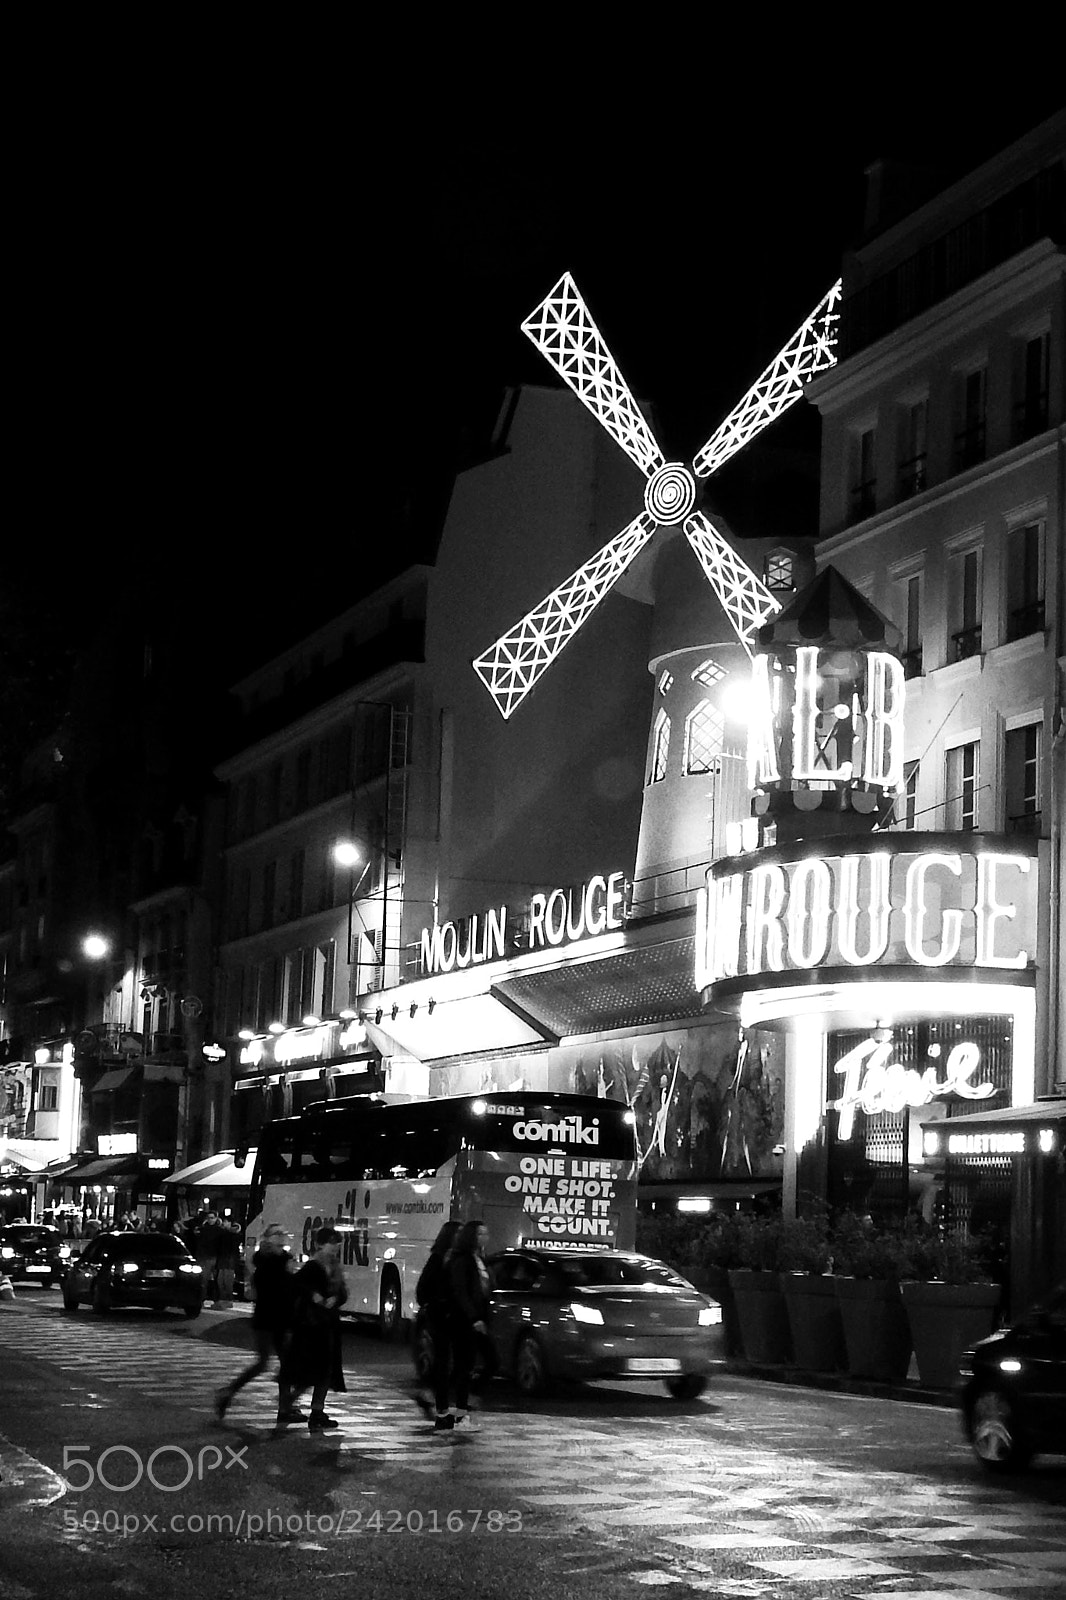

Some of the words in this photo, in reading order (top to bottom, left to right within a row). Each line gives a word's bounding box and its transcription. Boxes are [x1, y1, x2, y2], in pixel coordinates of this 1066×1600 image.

[421, 904, 507, 973] MOULIN
[529, 871, 624, 949] ROUGE
[746, 852, 1030, 972] ROUGE
[512, 1116, 599, 1145] contiki
[520, 1157, 565, 1177] ONE
[571, 1160, 618, 1180] LIFE.
[504, 1175, 551, 1195] ONE
[556, 1179, 616, 1199] SHOT.
[523, 1195, 586, 1215] MAKE
[592, 1199, 611, 1217] IT
[537, 1215, 614, 1237] COUNT.
